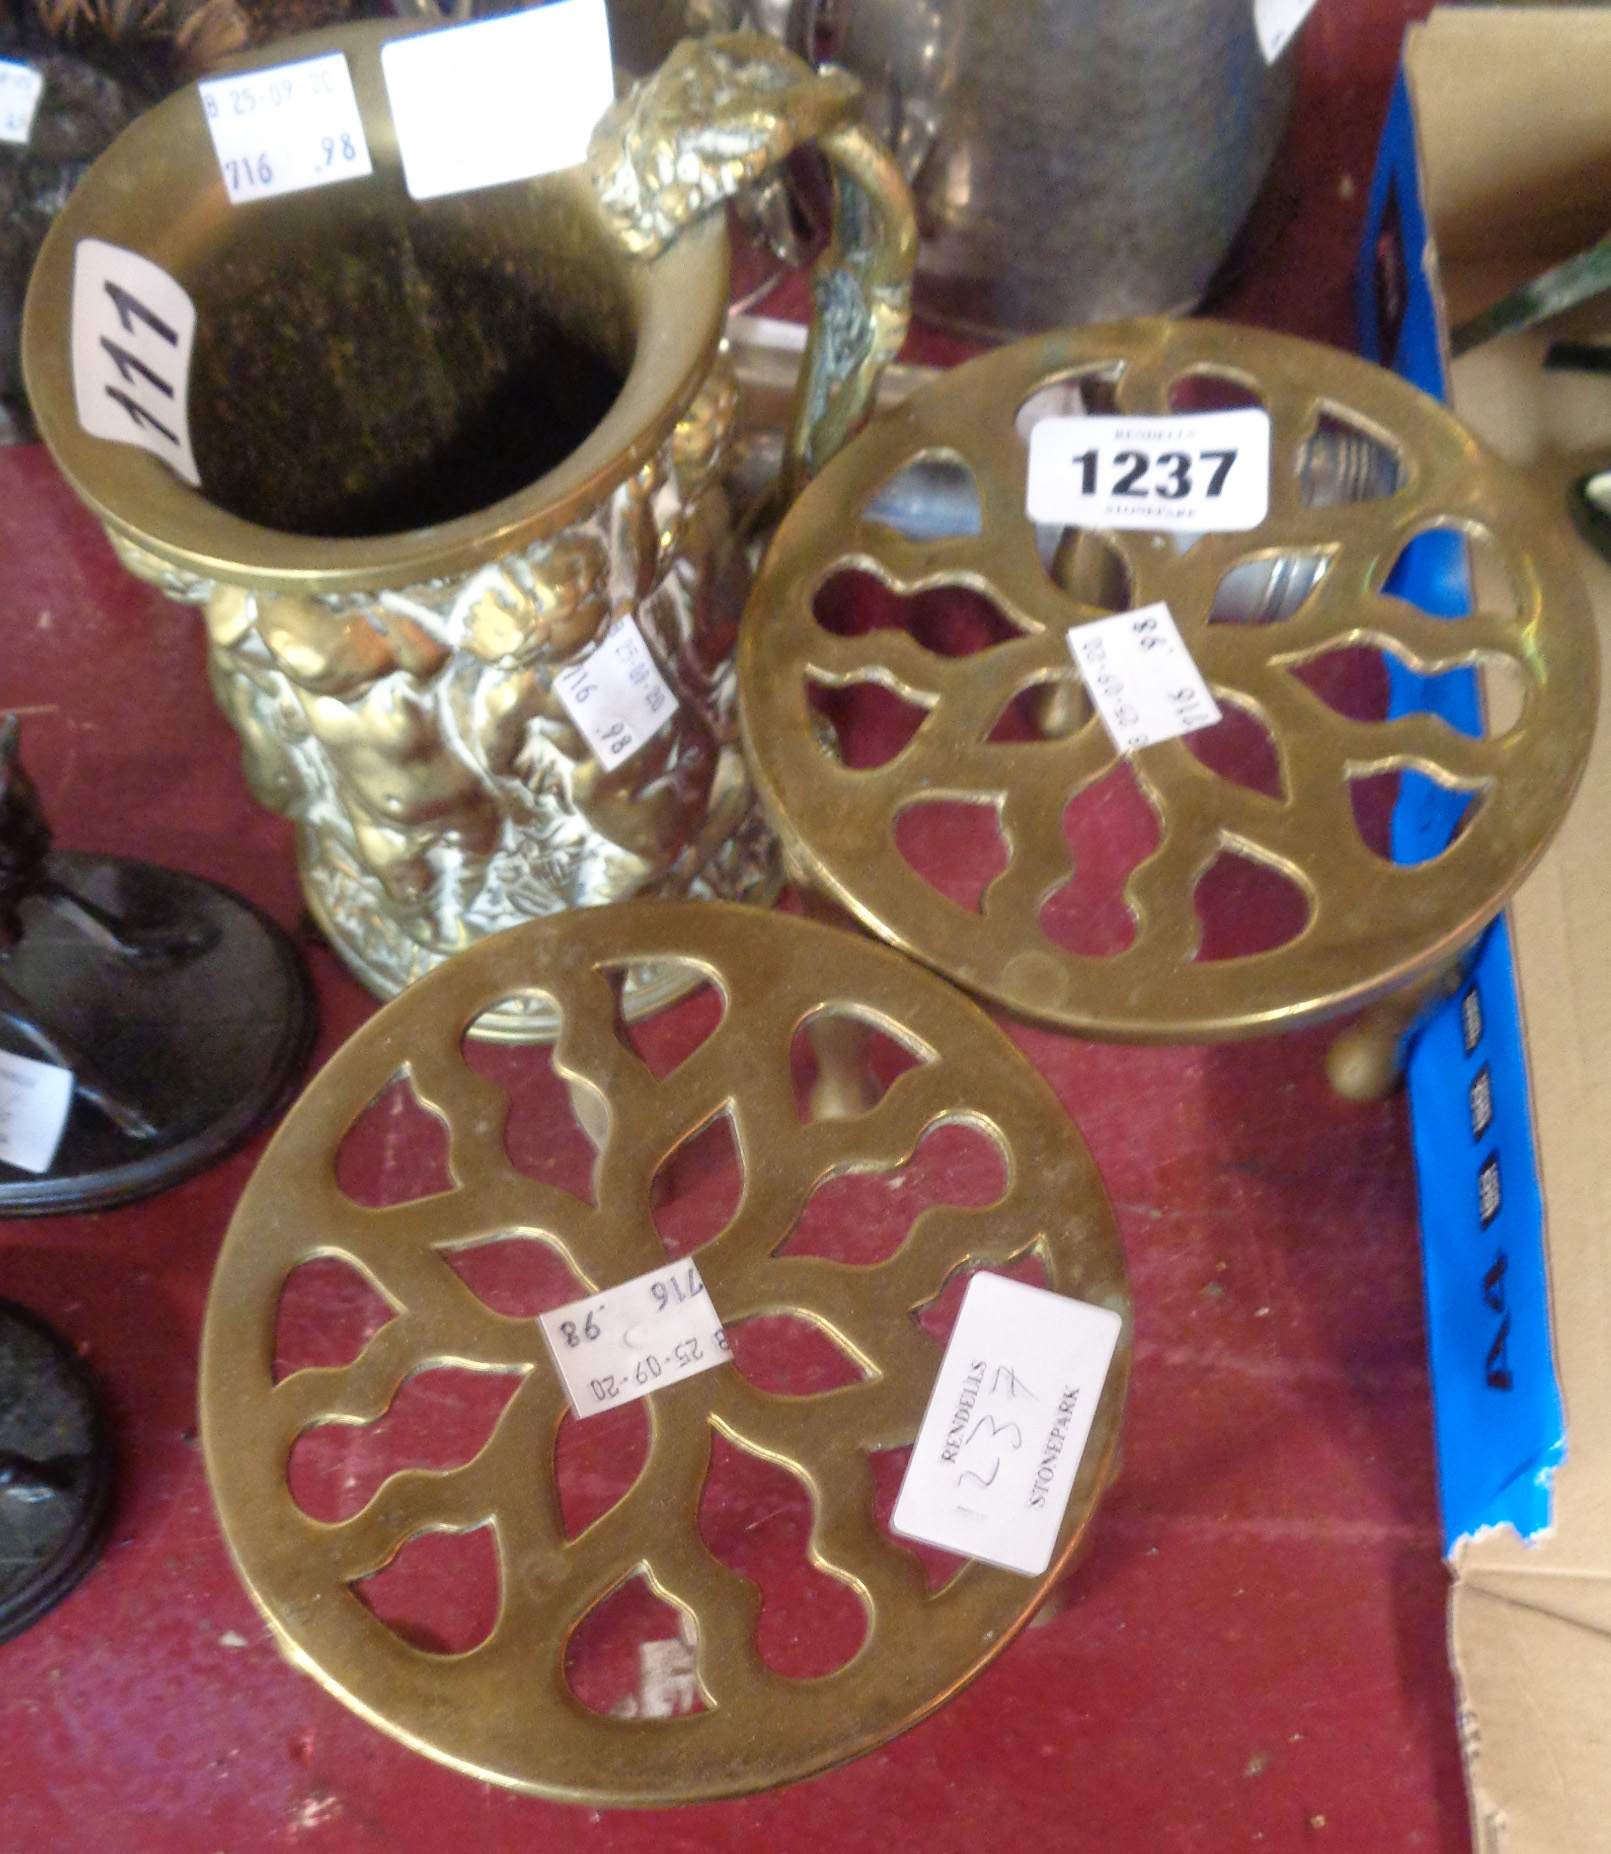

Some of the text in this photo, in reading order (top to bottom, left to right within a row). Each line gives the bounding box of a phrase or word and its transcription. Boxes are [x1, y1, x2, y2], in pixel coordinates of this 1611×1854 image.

[224, 151, 274, 192] 716
[1072, 448, 1238, 500] 1237
[1168, 687, 1209, 726] 716
[650, 1267, 704, 1311] 716
[941, 1358, 987, 1465] RENDELLS
[956, 1364, 1040, 1520] 1237
[1028, 1384, 1080, 1510] STONEPARK
